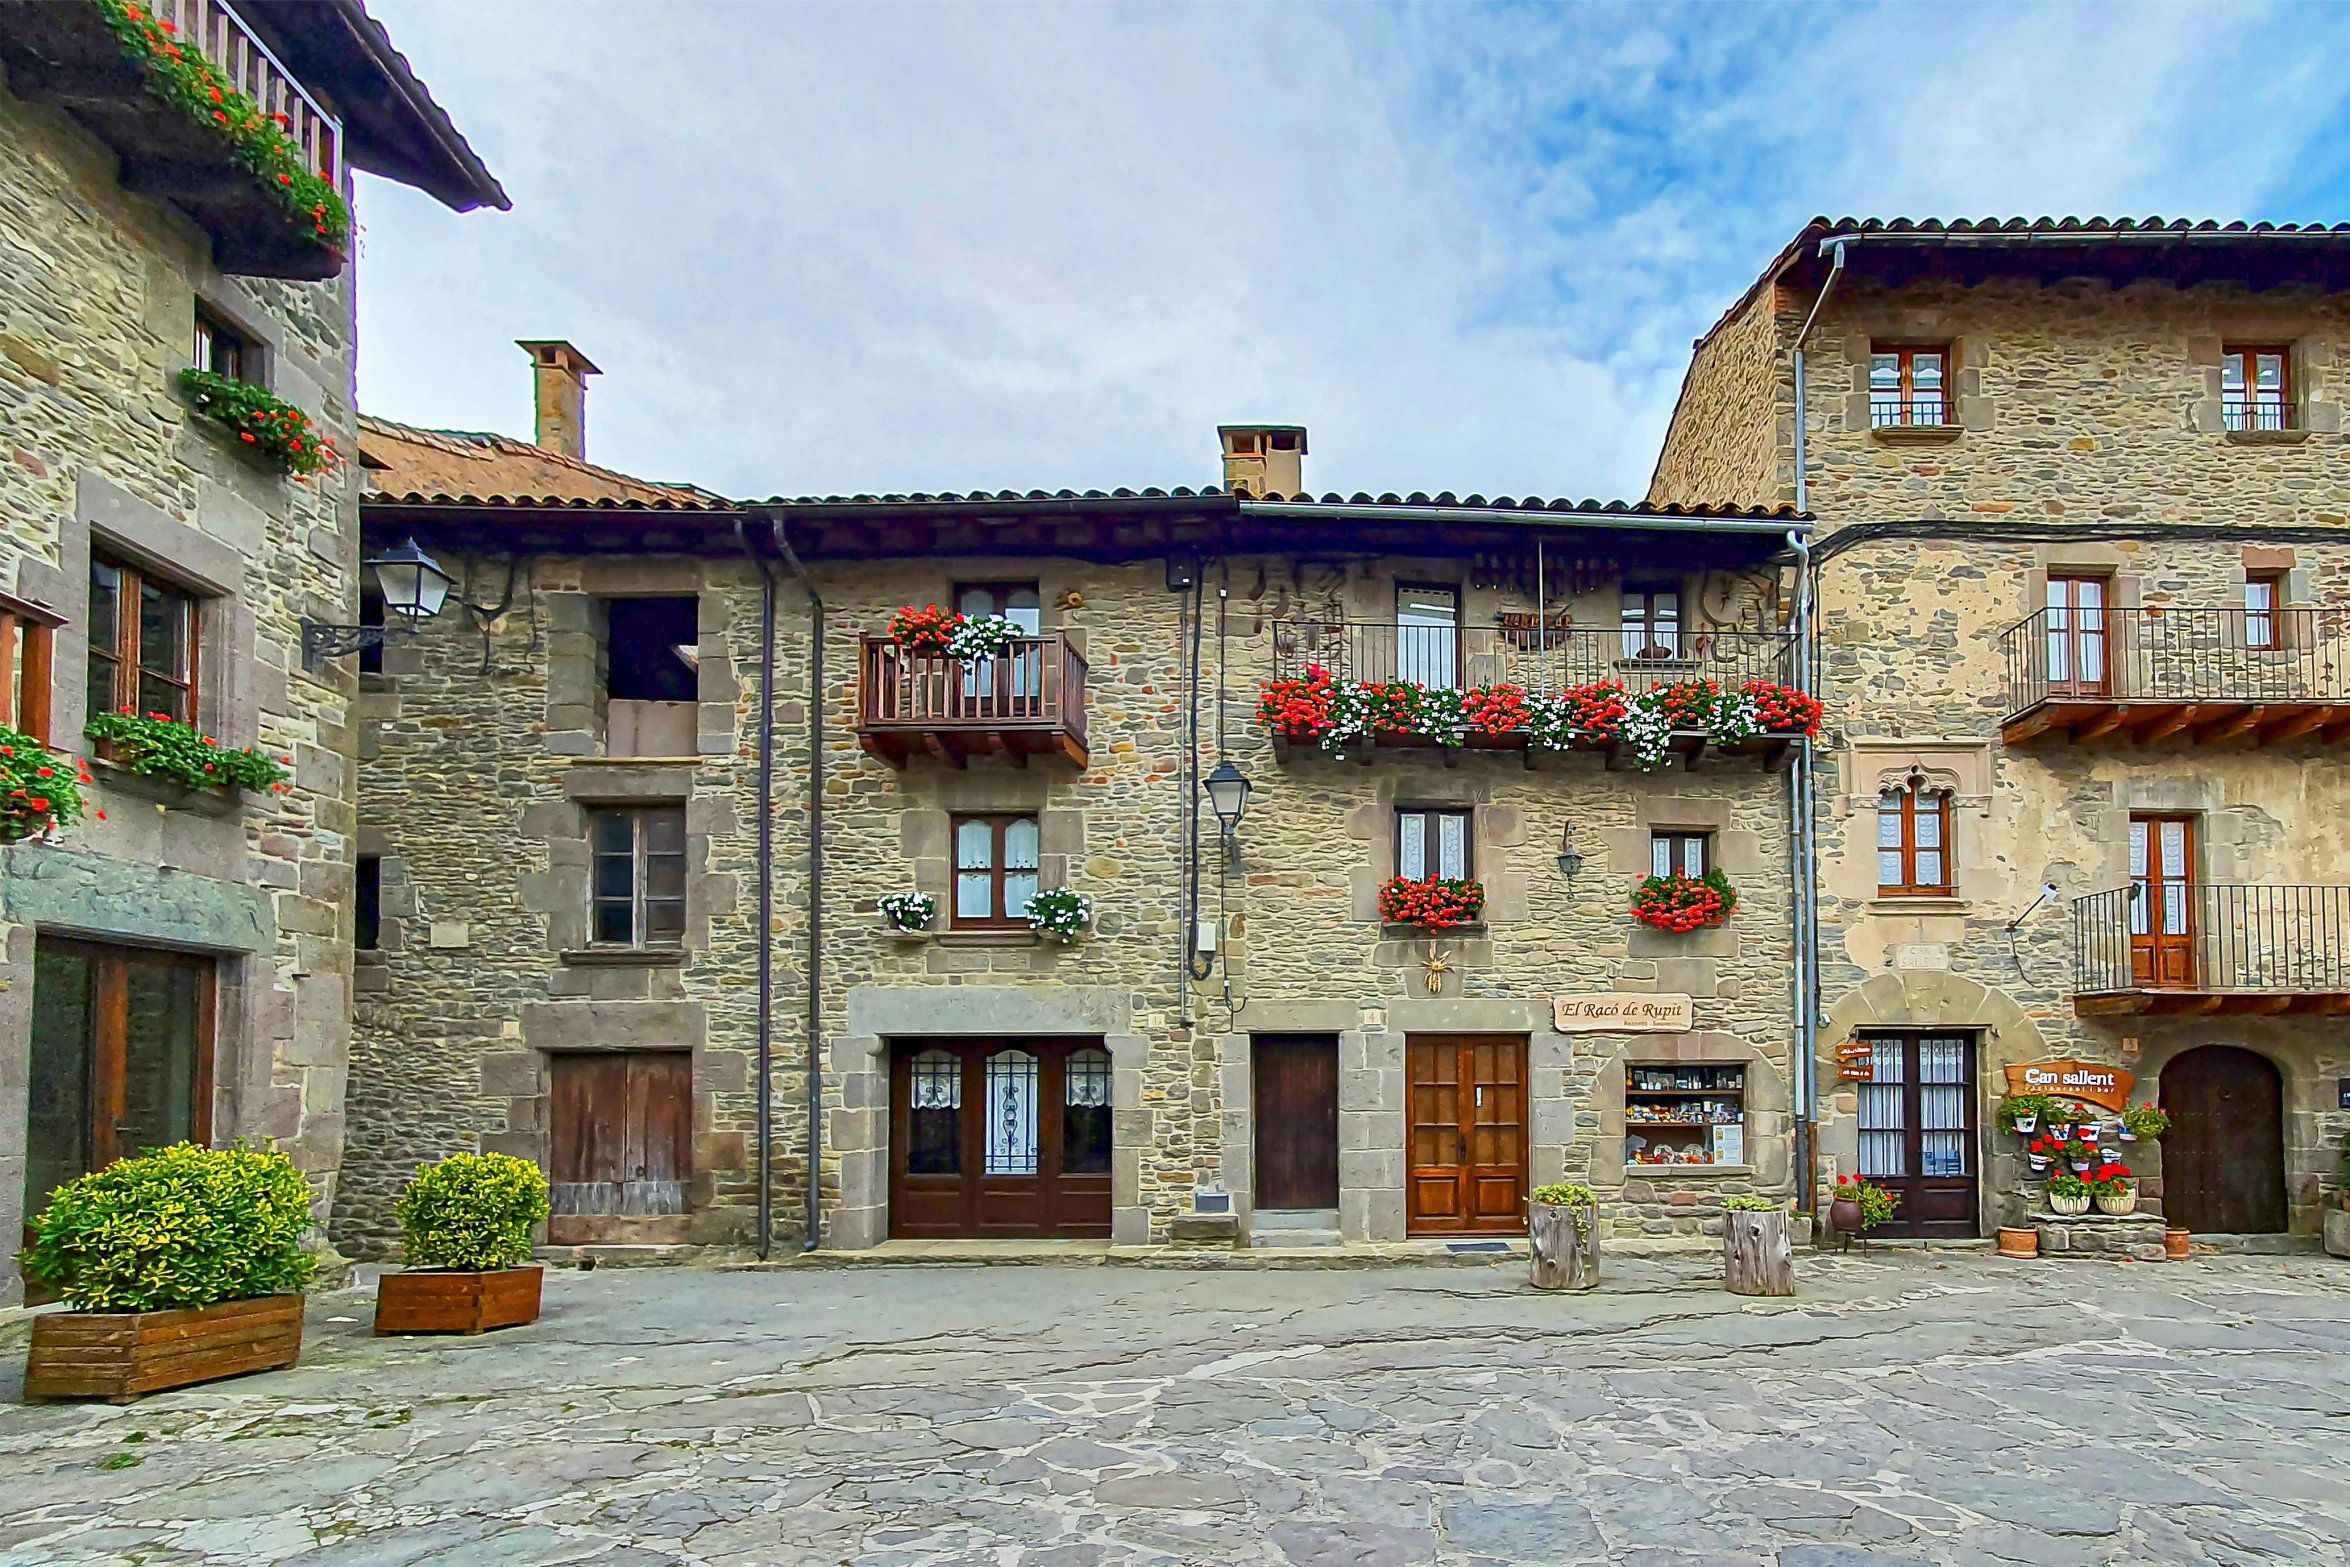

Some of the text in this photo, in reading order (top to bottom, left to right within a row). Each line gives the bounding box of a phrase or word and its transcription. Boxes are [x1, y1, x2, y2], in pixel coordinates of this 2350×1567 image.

[1369, 1012, 1375, 1023] 4
[1562, 1001, 1682, 1020] El Racó de Rupit
[2025, 1068, 2115, 1086] Can sallent
